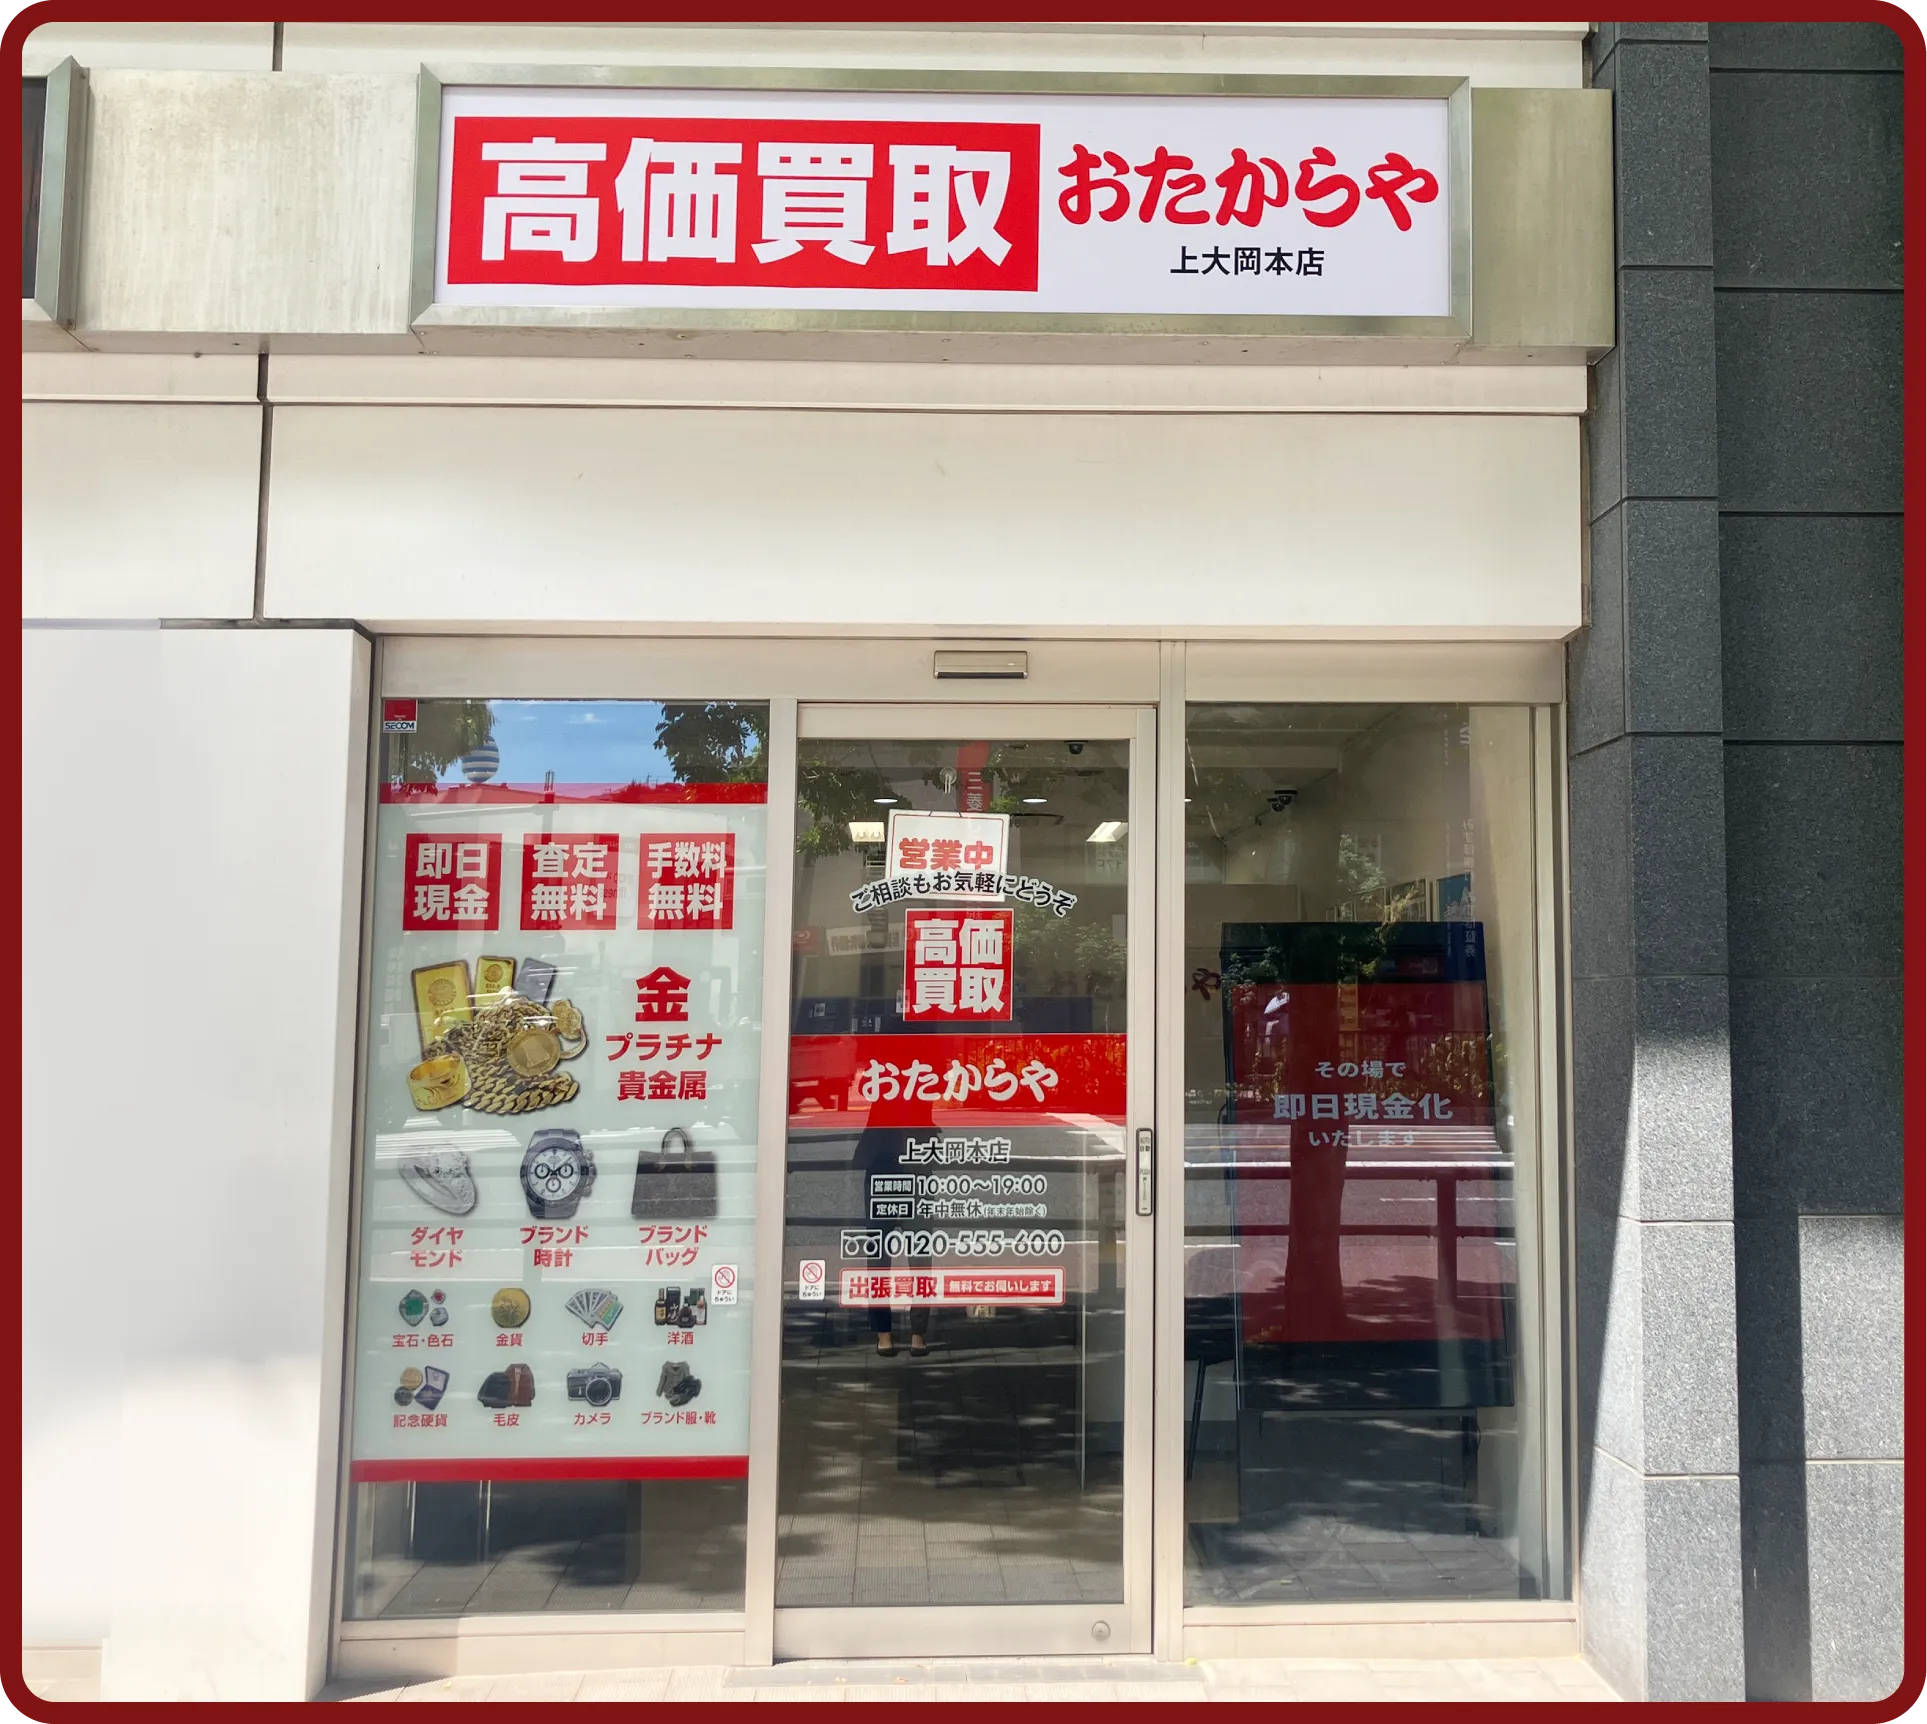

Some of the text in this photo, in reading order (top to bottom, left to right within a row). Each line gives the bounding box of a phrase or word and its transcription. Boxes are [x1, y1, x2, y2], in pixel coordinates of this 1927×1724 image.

[1057, 142, 1439, 232] おたからや
[480, 135, 1012, 269] 高価買取
[1170, 245, 1324, 277] 上大岡本店
[384, 721, 415, 730] SECOM
[415, 842, 490, 880] 即日
[532, 842, 609, 879] 査定
[647, 841, 727, 879] 手数料
[898, 837, 994, 871] 営業中
[413, 883, 491, 921] 現金
[530, 883, 607, 921] 無料
[647, 882, 724, 921] 無料
[850, 870, 1078, 918] ご相談もお気軽にどうぞ
[913, 918, 1005, 965] 高価
[635, 966, 692, 1023] 金
[912, 967, 1005, 1014] 買取
[606, 1032, 723, 1062] プラチナ
[860, 1058, 1059, 1103] おたからや
[1313, 1060, 1407, 1079] その場で
[617, 1070, 708, 1101] 貴金属
[1273, 1091, 1454, 1121] 即日現金化
[899, 1137, 1012, 1164] 上大岡本店
[1308, 1128, 1420, 1148] いたします
[874, 1180, 913, 1193] 営業時間
[875, 1203, 910, 1216] 定休日
[410, 1225, 465, 1245] ダイヤ
[520, 1225, 589, 1245] ブランド
[638, 1225, 708, 1244] ブランド
[884, 1230, 1065, 1258] 0120-555-600
[409, 1248, 463, 1268] モンド
[533, 1248, 573, 1268] 時計
[644, 1247, 700, 1267] バッグ
[848, 1276, 1052, 1299] 出張買取 無料でお伺いします
[392, 1333, 454, 1348] 宝石・色石
[496, 1333, 523, 1347] 金貨
[581, 1332, 608, 1346] 切手
[667, 1331, 694, 1345] 洋酒
[393, 1413, 448, 1428] 記念硬貨
[493, 1412, 520, 1427] 毛皮
[573, 1411, 612, 1425] カメラ
[641, 1410, 717, 1426] ブランド服・靴
